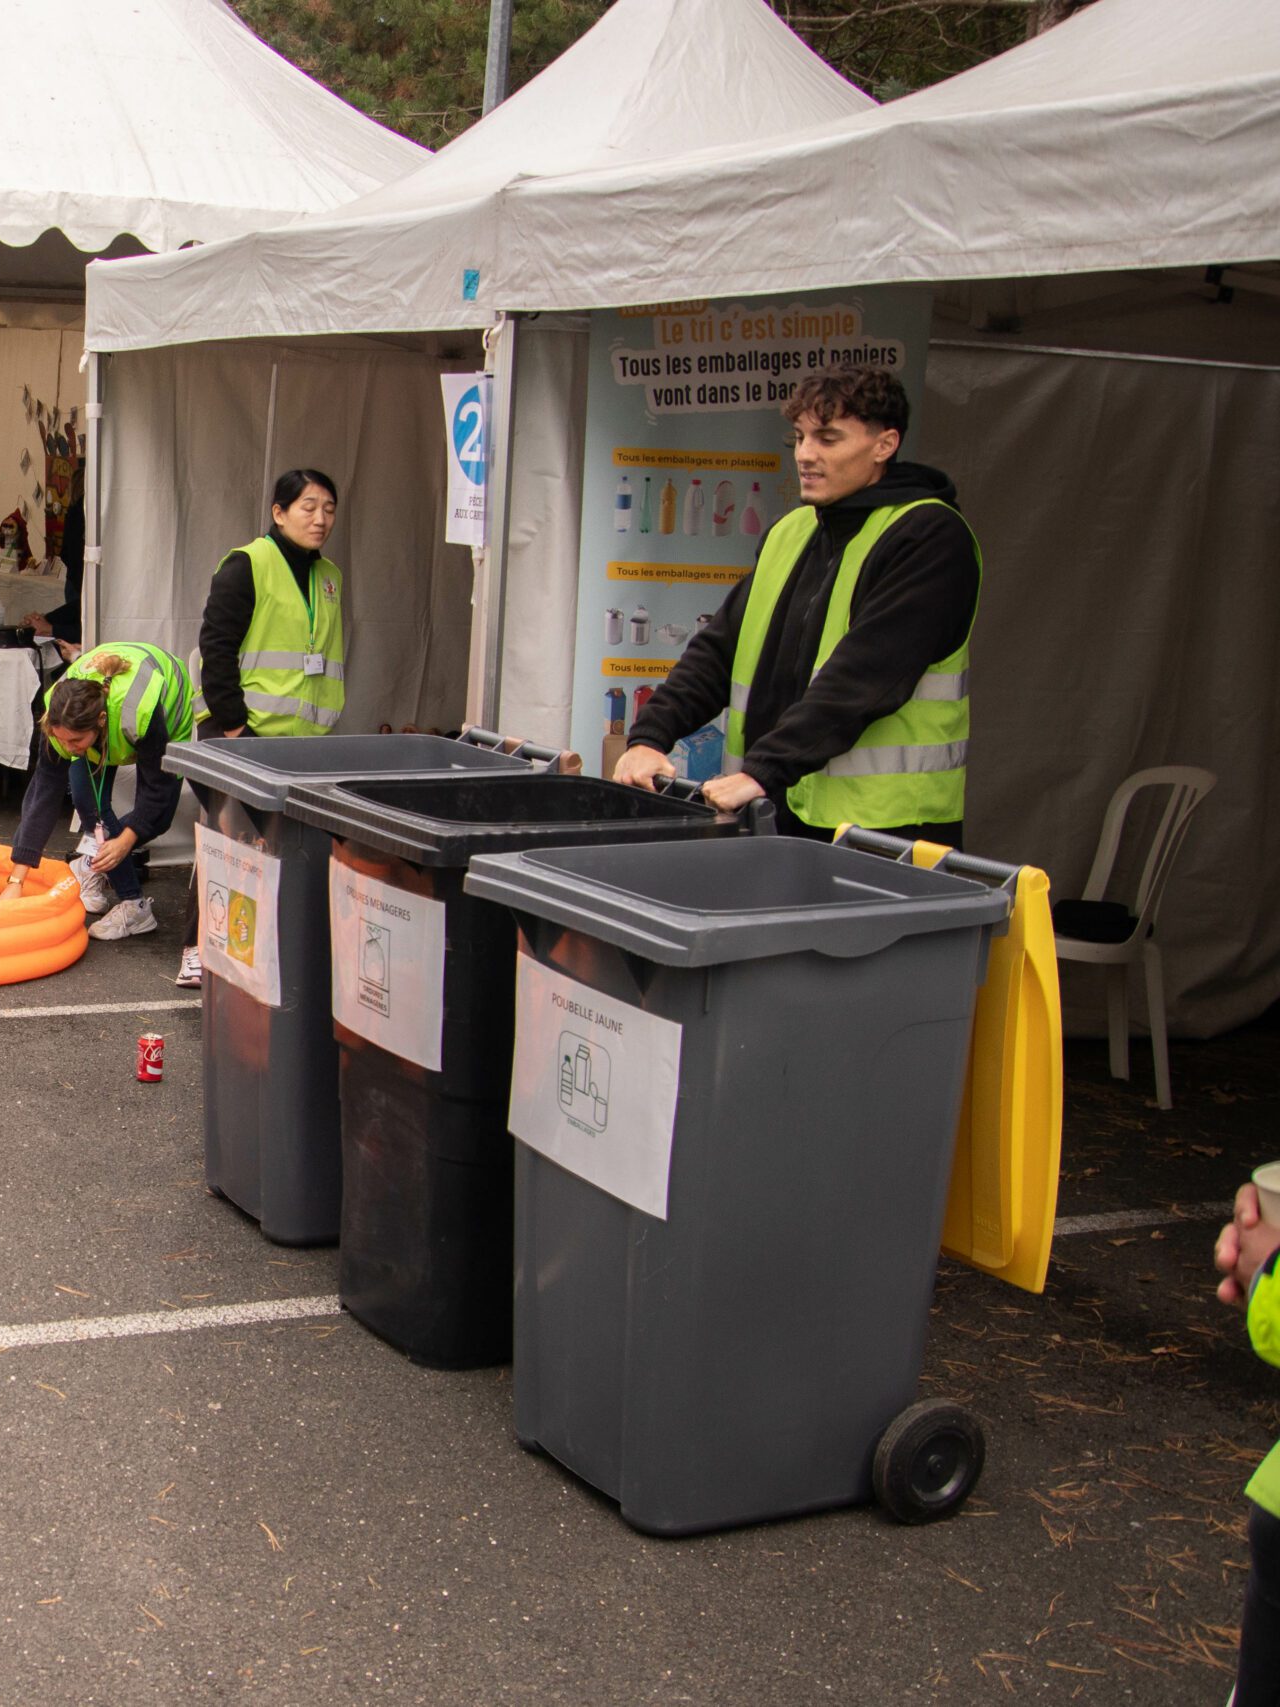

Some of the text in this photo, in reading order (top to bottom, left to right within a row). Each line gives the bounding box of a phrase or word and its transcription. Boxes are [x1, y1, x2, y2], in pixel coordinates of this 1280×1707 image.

[661, 319, 683, 344] Le
[691, 314, 714, 341] tri
[781, 310, 855, 344] simple
[619, 356, 661, 378] Tous
[666, 354, 692, 375] les
[698, 349, 801, 376] emballages
[807, 346, 825, 367] et
[653, 383, 692, 406] vont
[697, 382, 740, 404] dans
[746, 381, 762, 402] le
[459, 401, 484, 462] 2
[617, 453, 776, 469] Tous les emballages en plastique
[617, 567, 639, 576] Tous
[641, 568, 654, 577] les
[656, 568, 711, 580] emballages
[714, 572, 726, 580] en
[610, 664, 632, 673] Tous
[633, 664, 646, 673] les
[552, 993, 624, 1036] POUBELLE JAUNE
